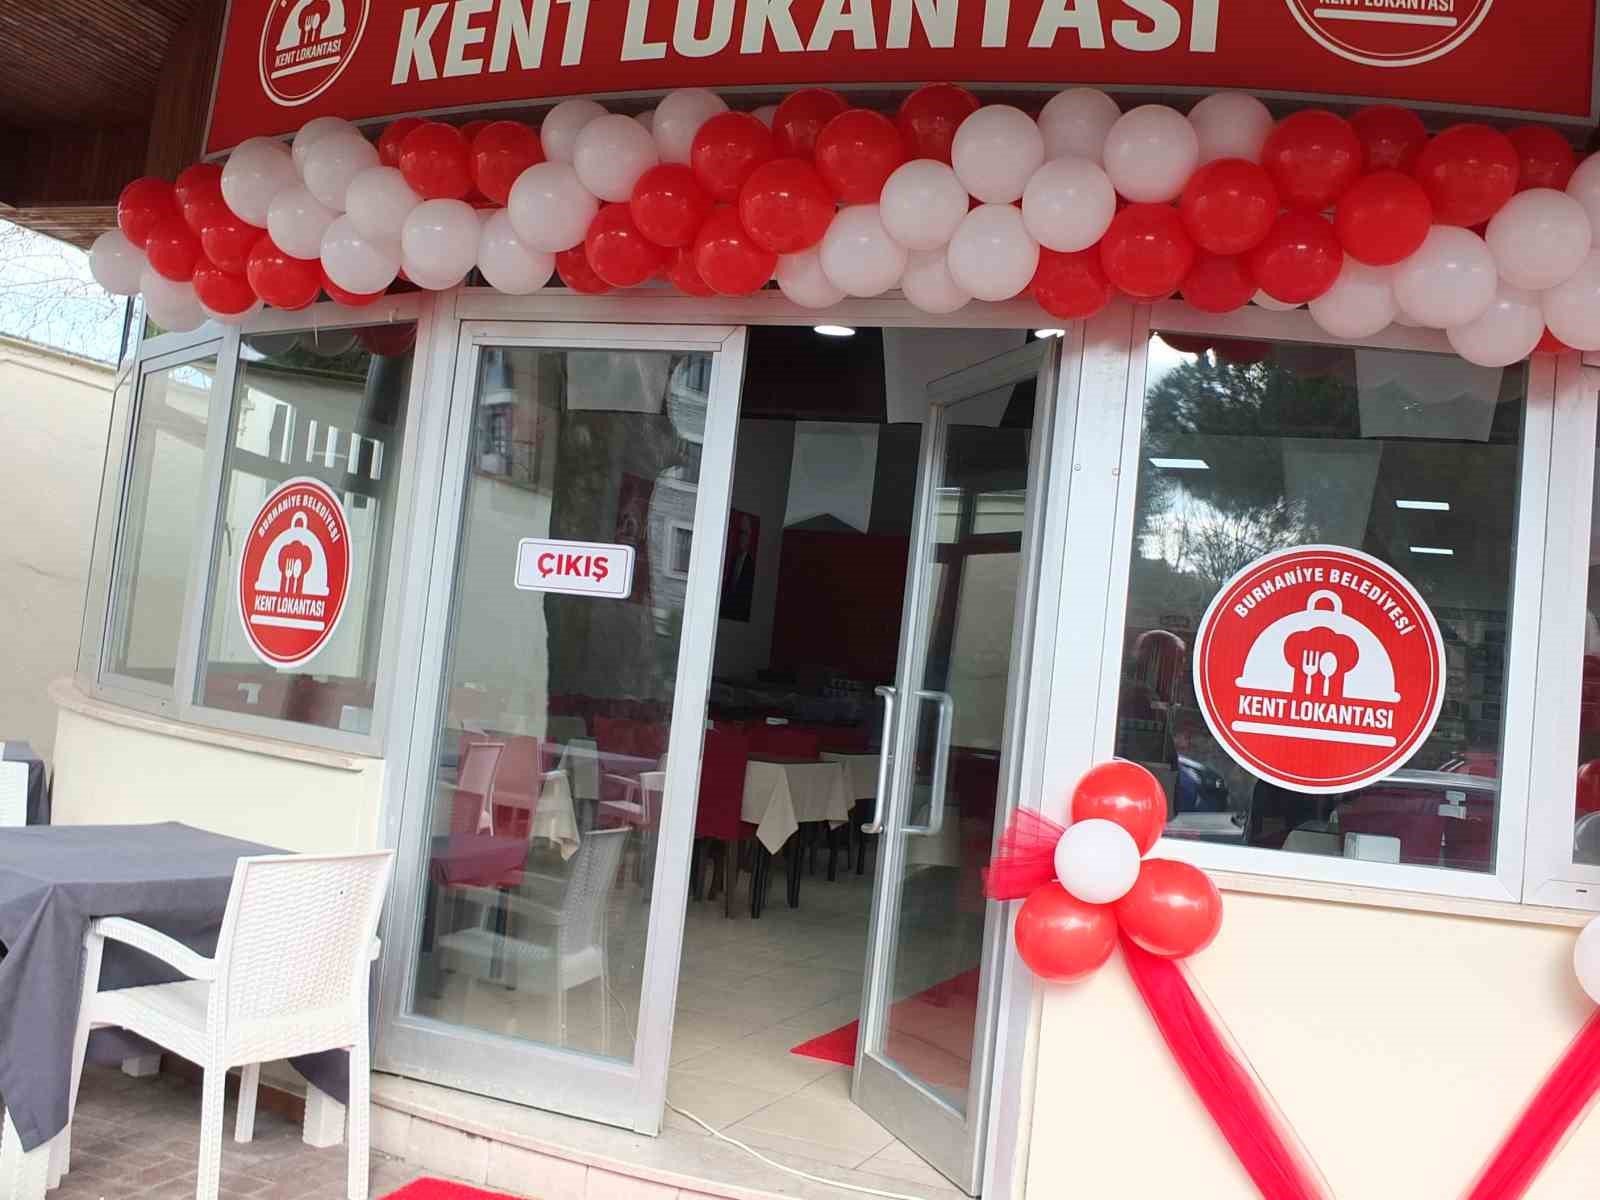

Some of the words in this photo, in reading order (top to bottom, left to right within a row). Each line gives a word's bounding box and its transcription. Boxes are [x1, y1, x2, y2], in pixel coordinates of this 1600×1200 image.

[275, 51, 296, 67] KENT
[295, 40, 341, 62] LOKANTASI
[391, 0, 590, 85] KENT
[619, 0, 1220, 62] LOKANTASI
[302, 494, 342, 543] BELEDİYESİ
[537, 552, 609, 583] ÇIKIŞ
[254, 595, 278, 612] KENT
[277, 596, 326, 617] LOKANTASI
[1233, 566, 1324, 618] BURHANİYE
[1329, 569, 1416, 636] BELEDİYESİ
[1238, 695, 1288, 718] KENT
[1290, 700, 1394, 729] LOKANTASI
